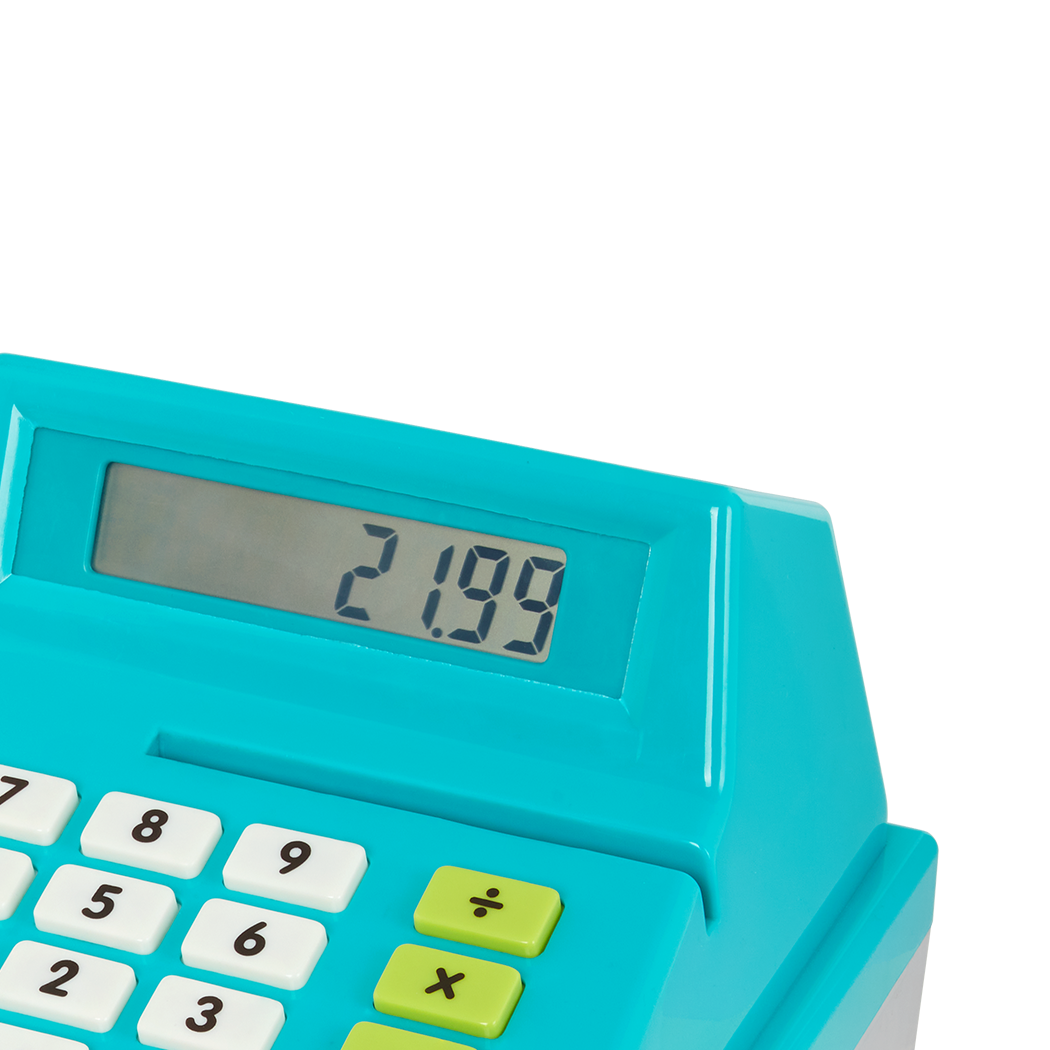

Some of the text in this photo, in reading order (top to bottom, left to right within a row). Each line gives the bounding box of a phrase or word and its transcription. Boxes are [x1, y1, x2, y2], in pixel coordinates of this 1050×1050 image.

[334, 522, 566, 656] 21.99
[130, 809, 169, 844] 8
[278, 840, 312, 875] 9
[80, 883, 123, 920] 5
[232, 920, 268, 957] 6
[37, 958, 80, 998] 2
[184, 994, 224, 1033] 3
